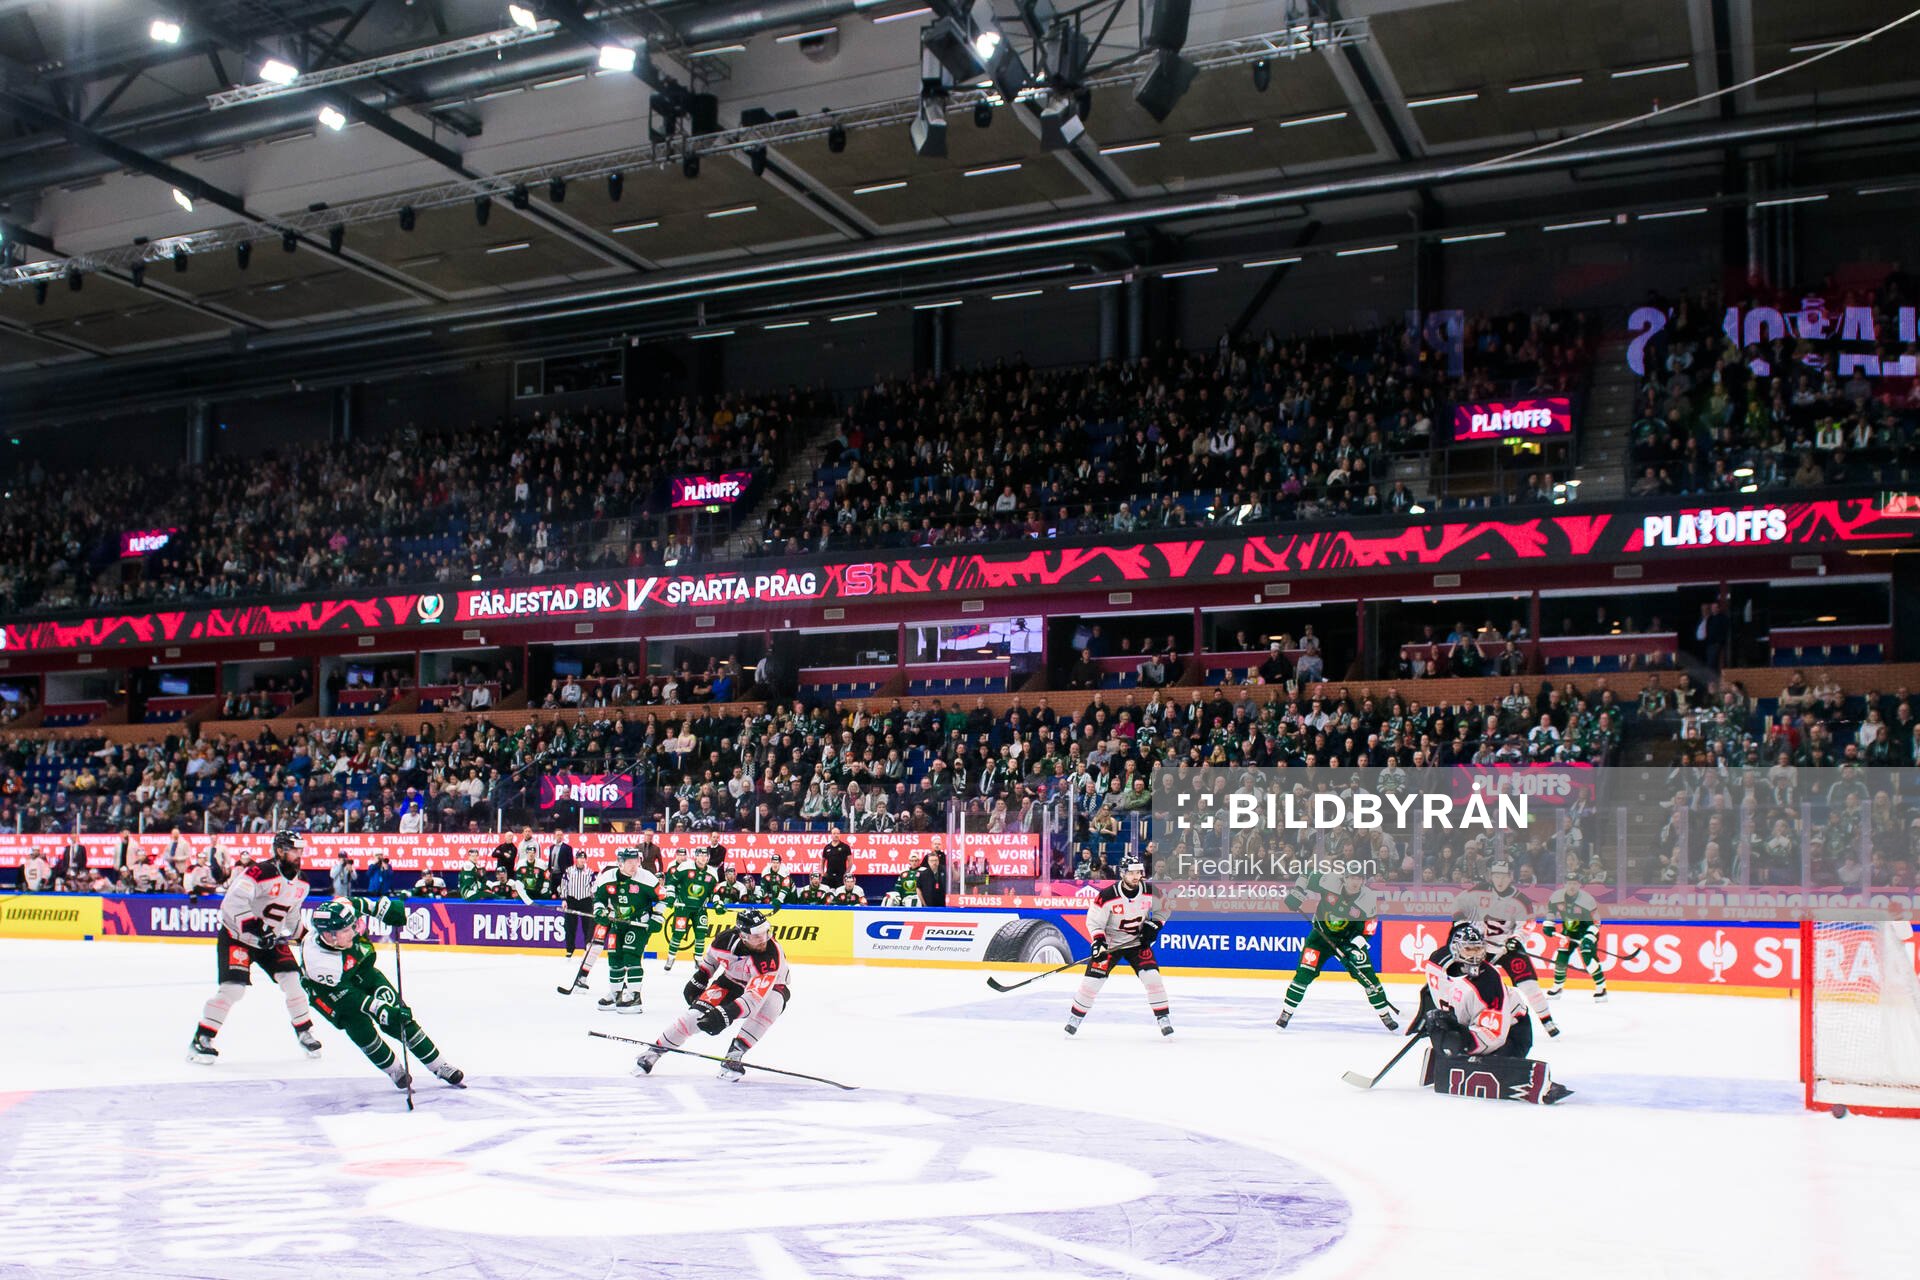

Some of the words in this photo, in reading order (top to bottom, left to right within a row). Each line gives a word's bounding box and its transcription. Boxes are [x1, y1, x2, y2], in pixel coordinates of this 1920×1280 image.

[1643, 509, 1787, 547] PLAYOFFS
[469, 589, 577, 616] FÄRJESTAD
[583, 586, 611, 608] BK
[667, 578, 750, 604] SPARTA
[755, 573, 816, 598] PRAG
[555, 782, 618, 802] PAYOFFS
[311, 836, 360, 844] WORKWEAR
[382, 836, 419, 844] STRAUSS
[443, 835, 500, 844] WORKWEAR
[598, 835, 660, 844] WORKWER
[690, 835, 736, 844] STRUSS
[868, 835, 919, 844] STRAUSS
[955, 835, 1028, 845] WORKWEAR
[412, 847, 450, 856] STRAUSS
[728, 848, 775, 858] STRAUSS
[6, 908, 79, 922] WARRIOR
[958, 897, 1002, 906] STRAUSS
[1034, 898, 1091, 907] WORKWEA
[1212, 901, 1279, 910] WORKWEAR
[1404, 903, 1450, 913] WORKW
[1608, 907, 1683, 916] WORKWEAR
[1722, 908, 1776, 918] STRAUSS
[473, 912, 566, 942] PLAYOFFS
[866, 921, 977, 940] GT
[926, 928, 975, 936] RADIAL
[872, 943, 911, 951] Experience
[1160, 934, 1229, 950] PRIVATE
[1236, 936, 1305, 952] BANKIN
